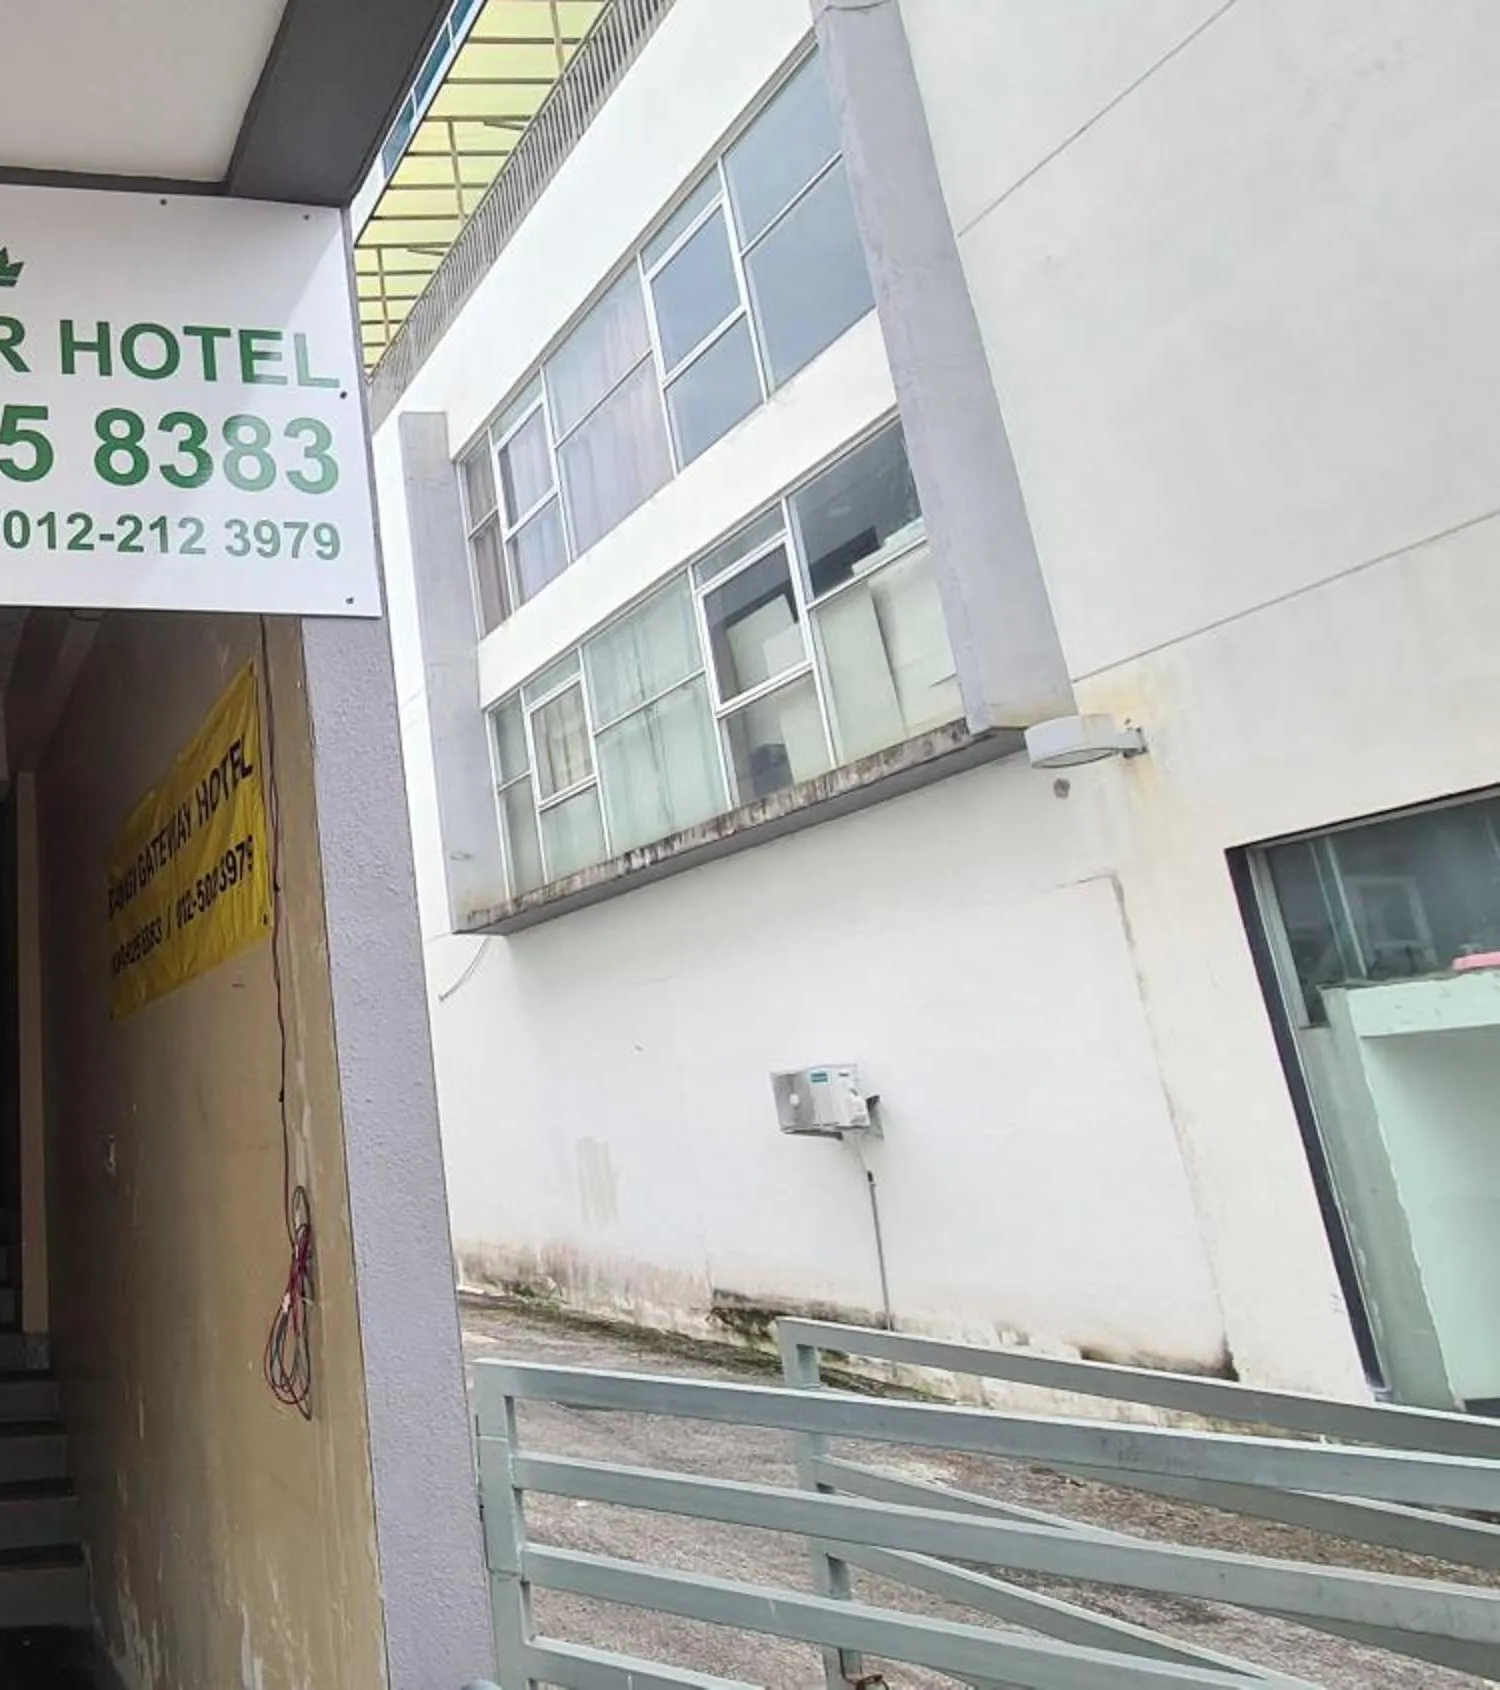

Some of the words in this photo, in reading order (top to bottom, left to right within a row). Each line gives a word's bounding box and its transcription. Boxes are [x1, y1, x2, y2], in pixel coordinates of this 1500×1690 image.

[60, 319, 340, 389] HOTEL
[93, 408, 340, 494] 8383
[225, 519, 341, 560] 3979
[196, 732, 253, 828] HOTEL
